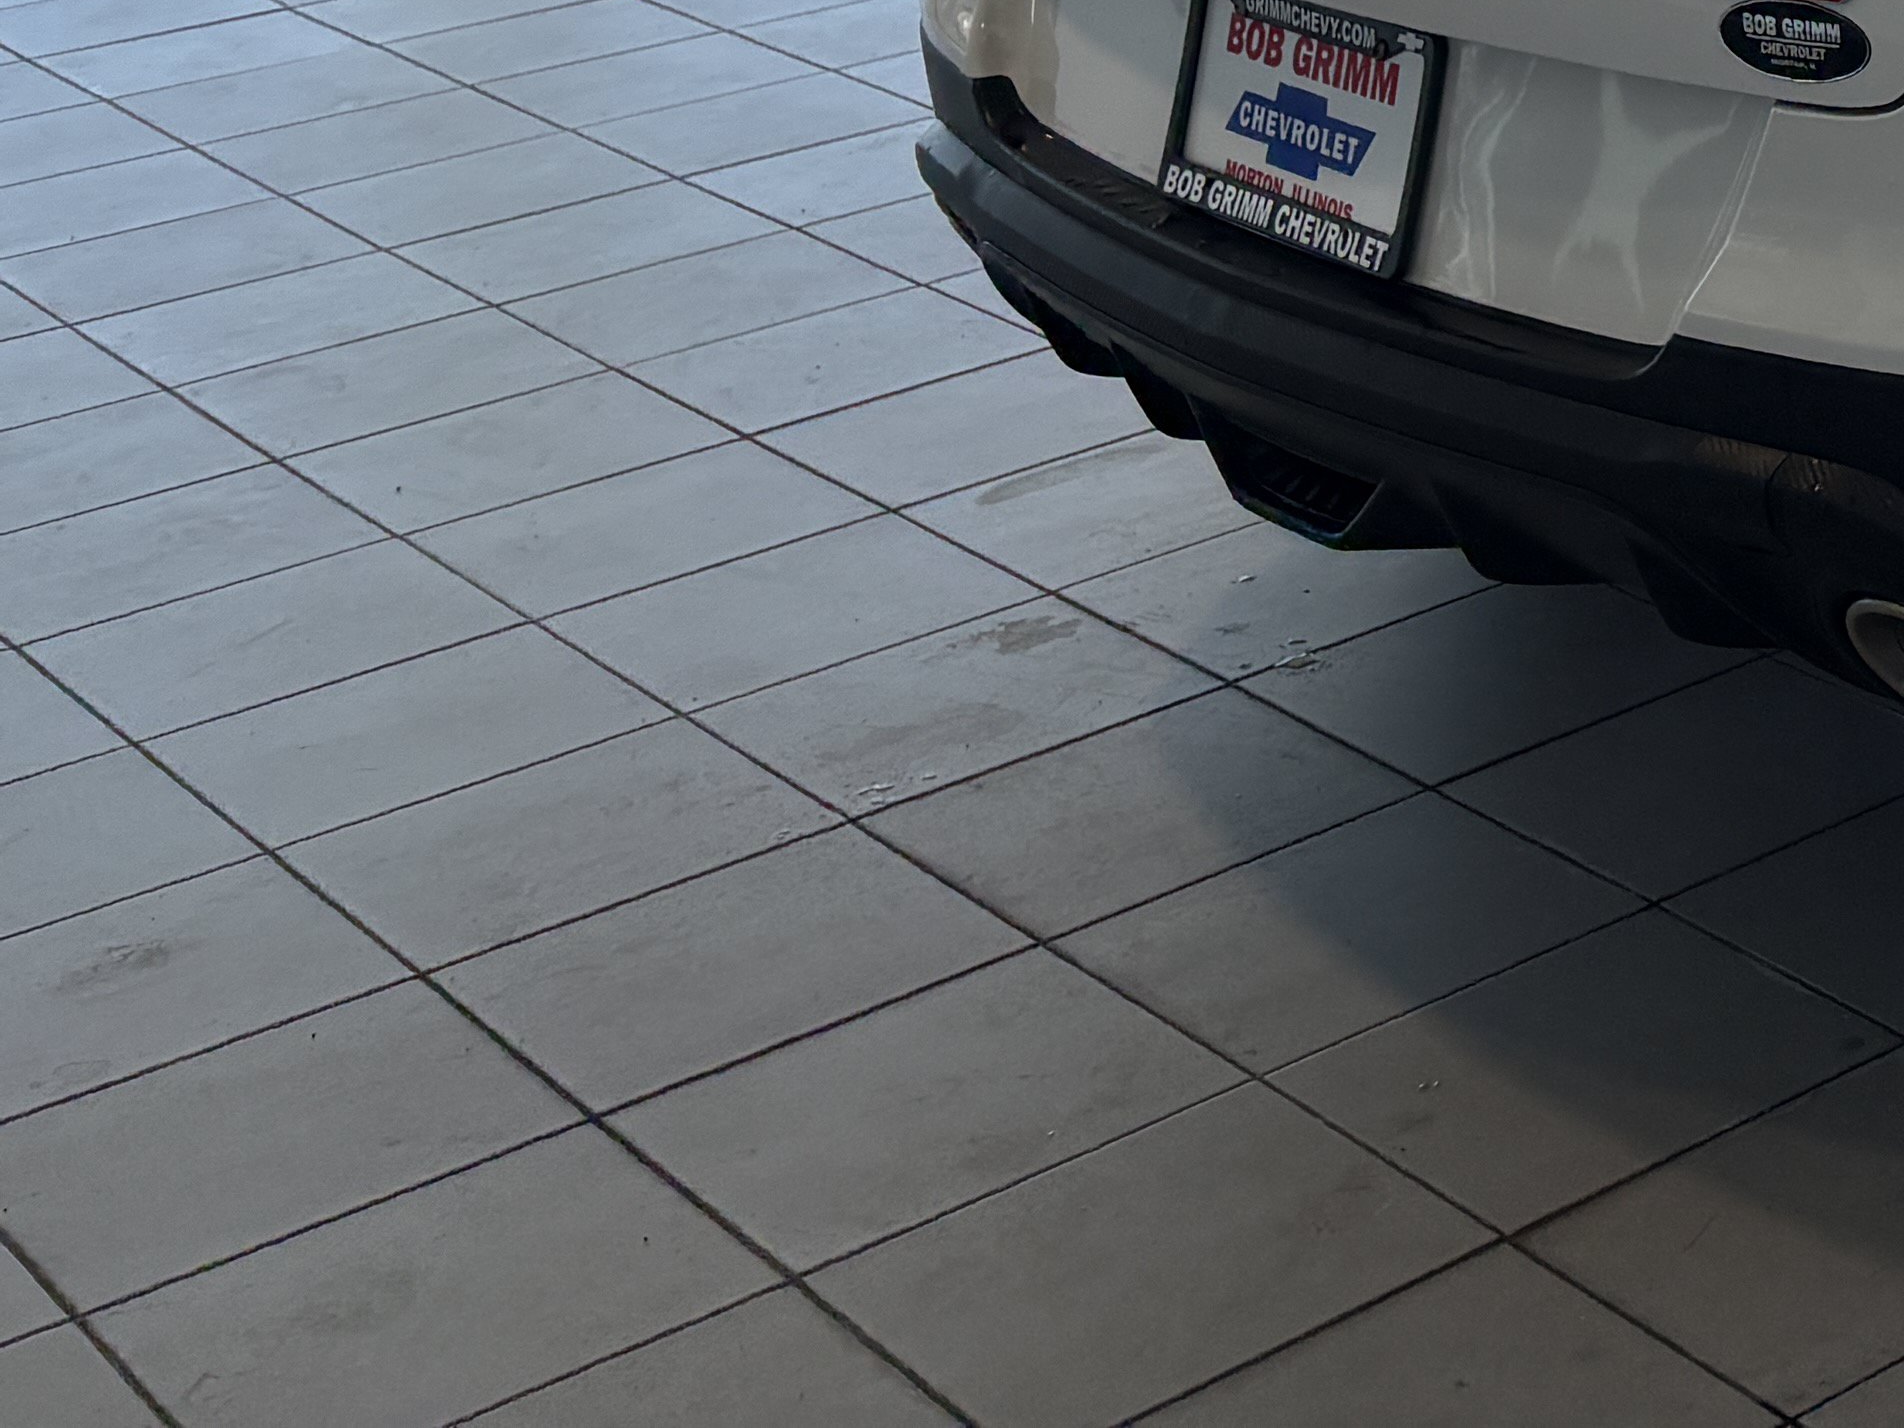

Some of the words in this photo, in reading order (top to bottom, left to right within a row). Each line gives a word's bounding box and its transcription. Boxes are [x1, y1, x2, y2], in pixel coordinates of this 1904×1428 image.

[1226, 11, 1286, 68] BOB
[1292, 33, 1401, 106] GRIMM
[1742, 12, 1777, 36] BOB
[1781, 17, 1841, 44] GRIMM
[1760, 41, 1826, 61] CHEVROLET
[1238, 100, 1359, 164] CHEVROLET
[1163, 164, 1206, 203] BOB
[1207, 180, 1274, 229] GRIMM
[1274, 204, 1389, 272] CHEVROLET
[1225, 158, 1285, 194] MORTON
[1292, 183, 1354, 219] ILLINOIS
